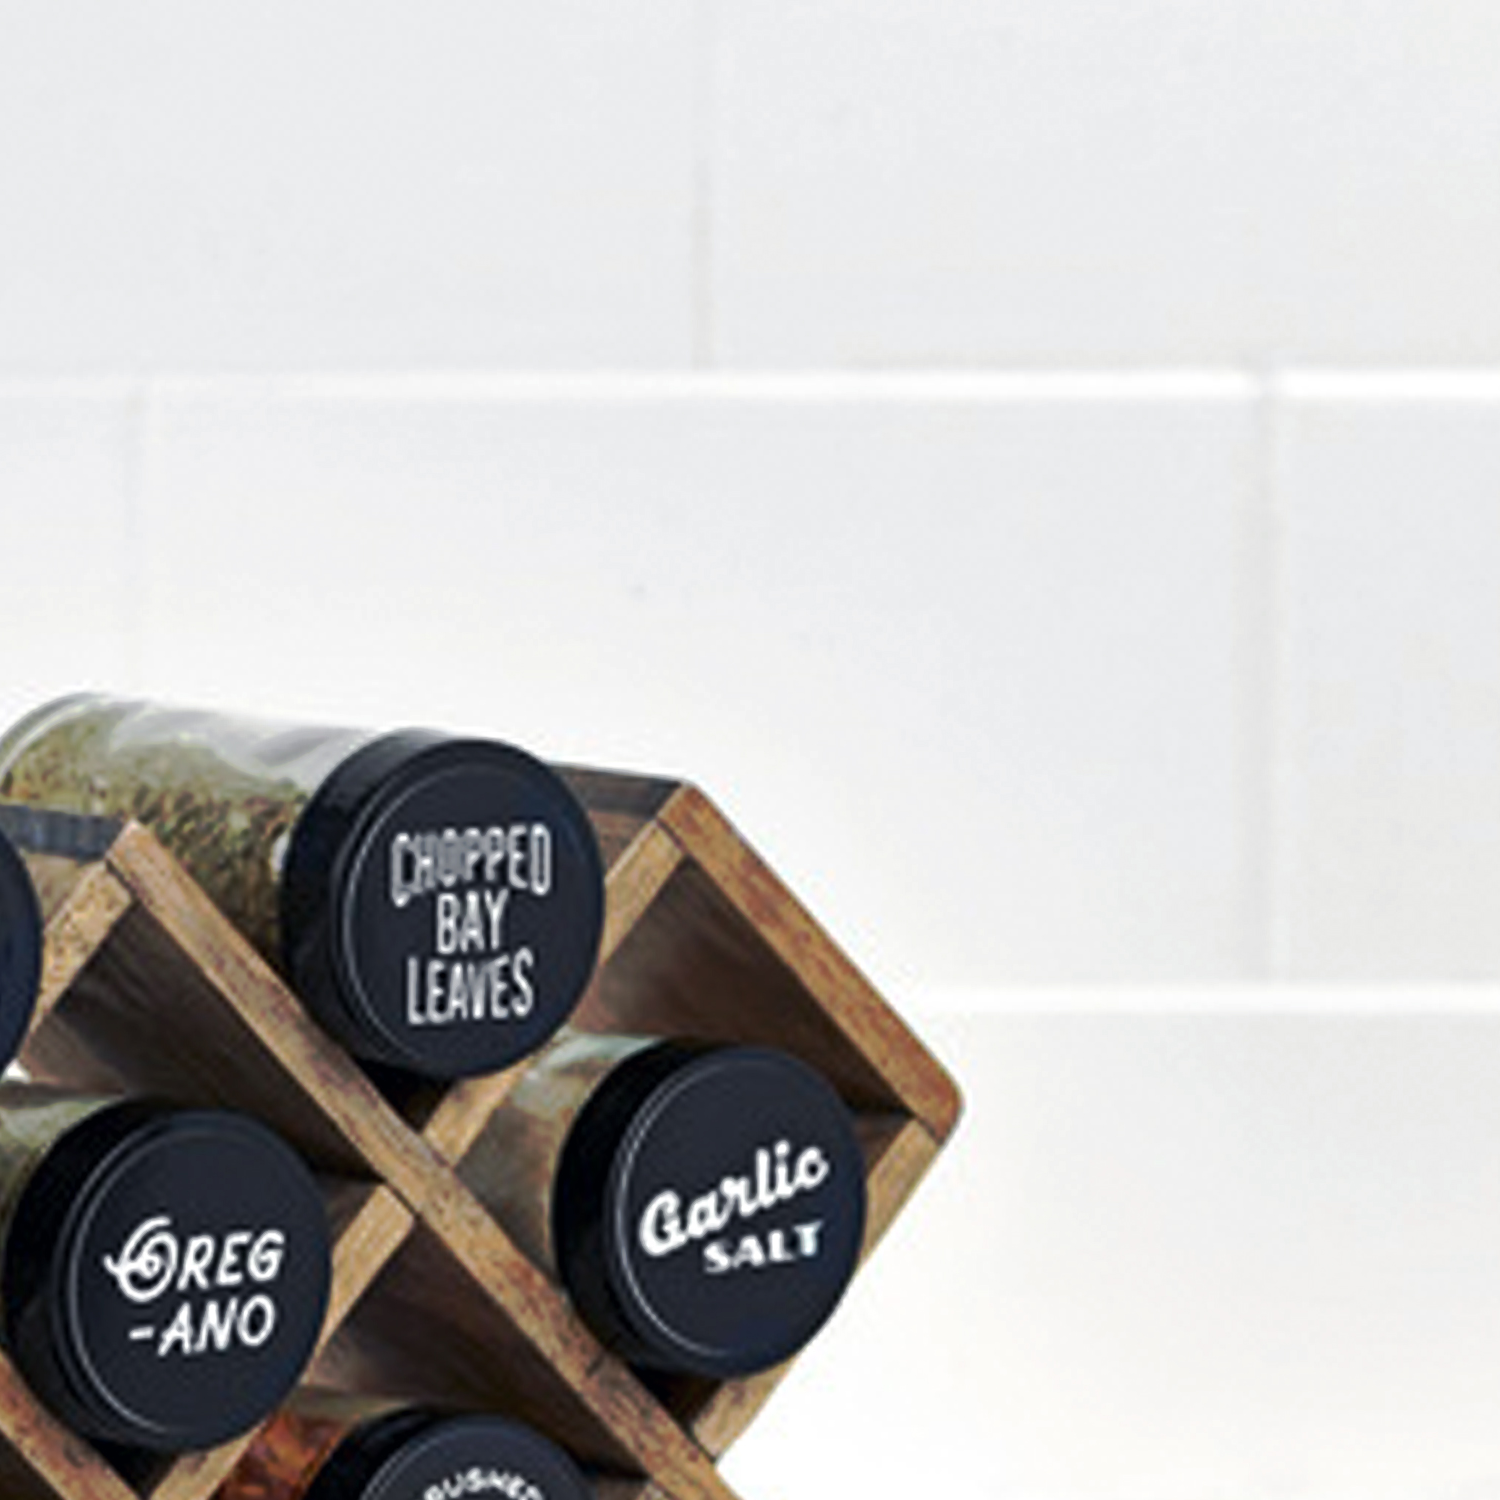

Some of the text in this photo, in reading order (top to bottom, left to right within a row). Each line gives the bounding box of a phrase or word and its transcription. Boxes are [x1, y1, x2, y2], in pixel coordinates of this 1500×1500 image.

[389, 823, 553, 907] CHOPPED
[436, 889, 507, 956] BAY
[406, 946, 535, 1026] LEAVES
[638, 1137, 830, 1258] Garlic
[103, 1215, 286, 1303] OREG
[703, 1220, 824, 1274] SALT
